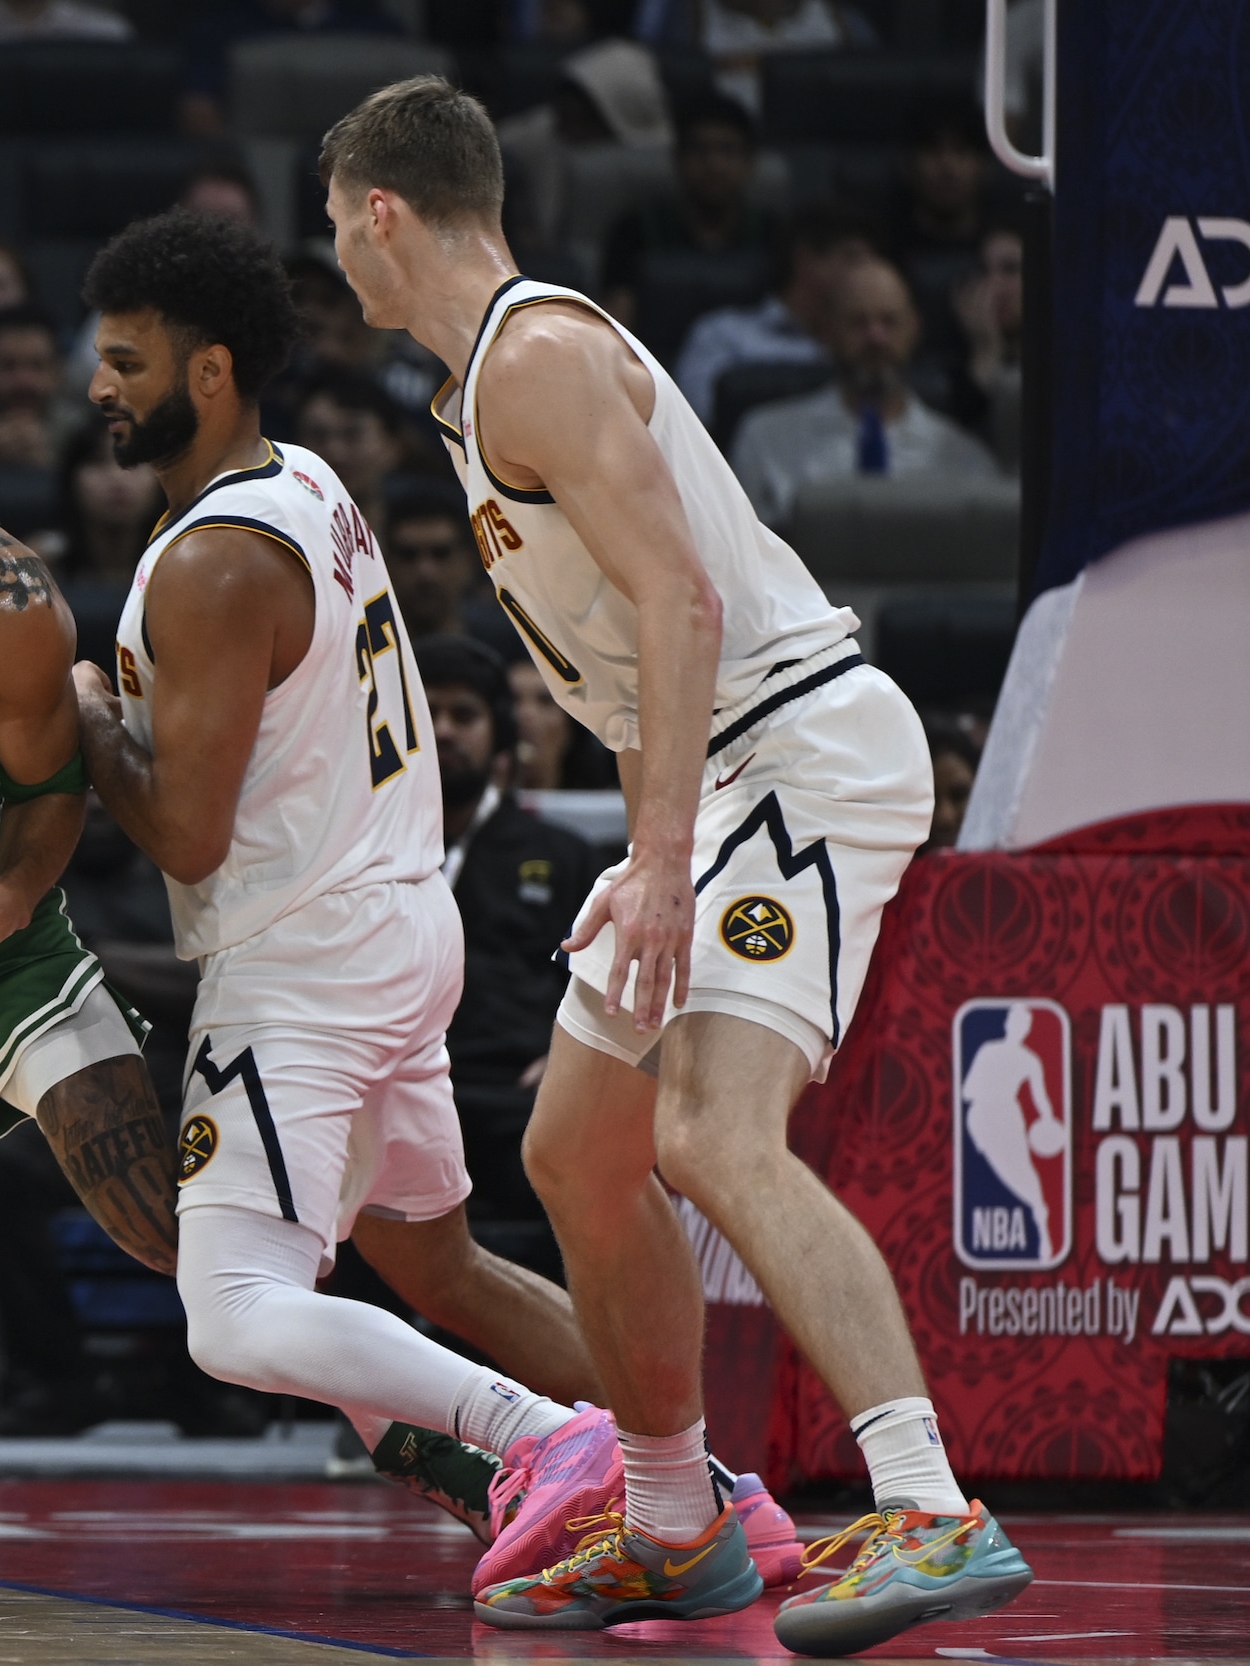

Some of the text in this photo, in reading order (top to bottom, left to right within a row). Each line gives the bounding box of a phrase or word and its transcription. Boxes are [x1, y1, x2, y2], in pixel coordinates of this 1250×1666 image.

[356, 586, 421, 794] 27
[1091, 1002, 1237, 1132] ABU
[971, 1205, 1028, 1251] NBA
[1094, 1134, 1249, 1264] GAM
[958, 1275, 1101, 1336] Presented
[1106, 1275, 1140, 1345] by
